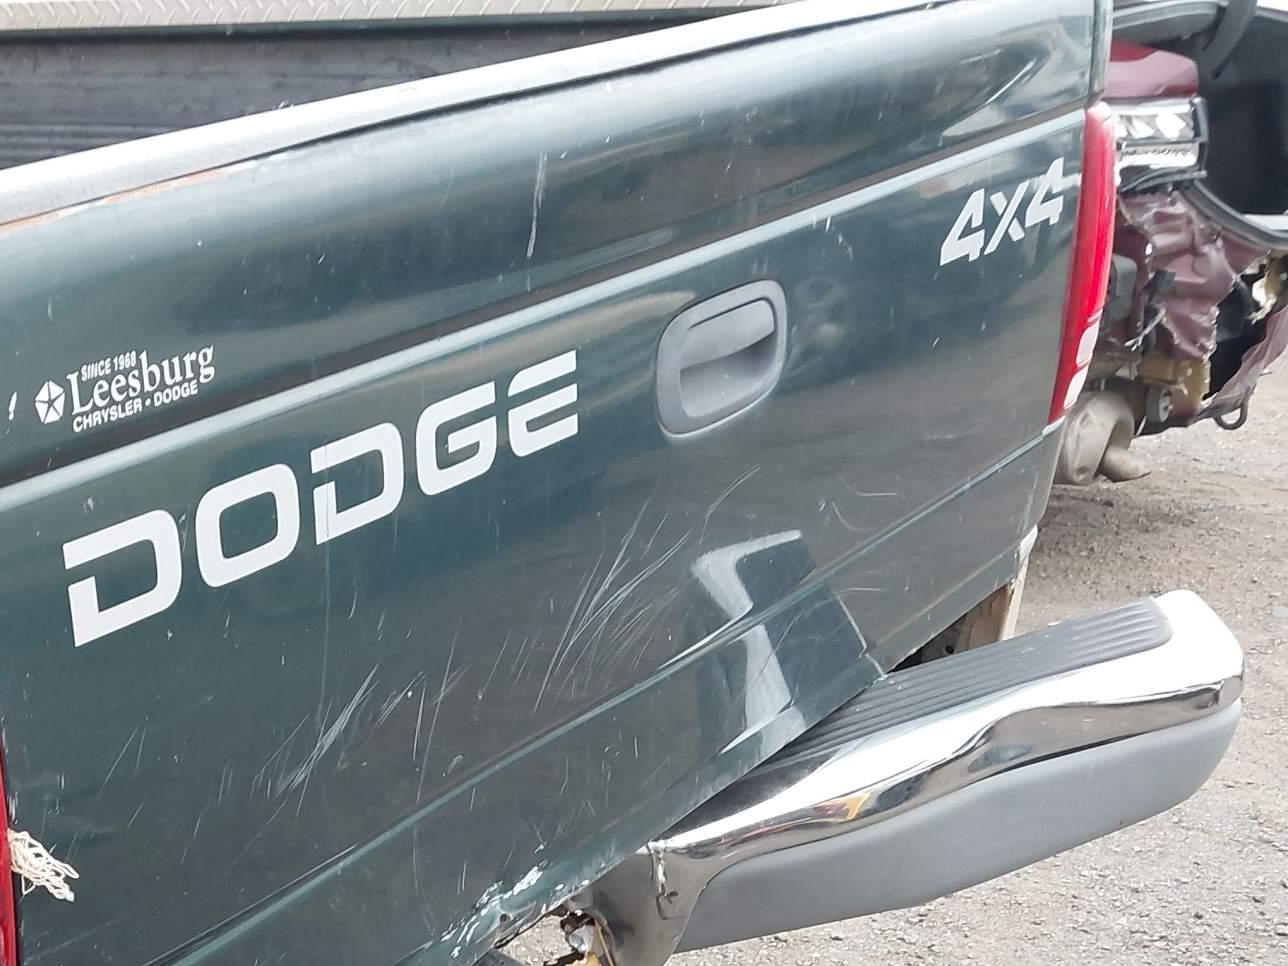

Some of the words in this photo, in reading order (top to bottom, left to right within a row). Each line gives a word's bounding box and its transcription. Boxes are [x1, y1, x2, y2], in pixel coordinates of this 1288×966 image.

[66, 344, 215, 416] Leesburg
[81, 357, 111, 382] SINCE
[73, 398, 143, 433] CHRYSLER
[153, 379, 198, 407] DODGE
[63, 350, 579, 647] DODGE
